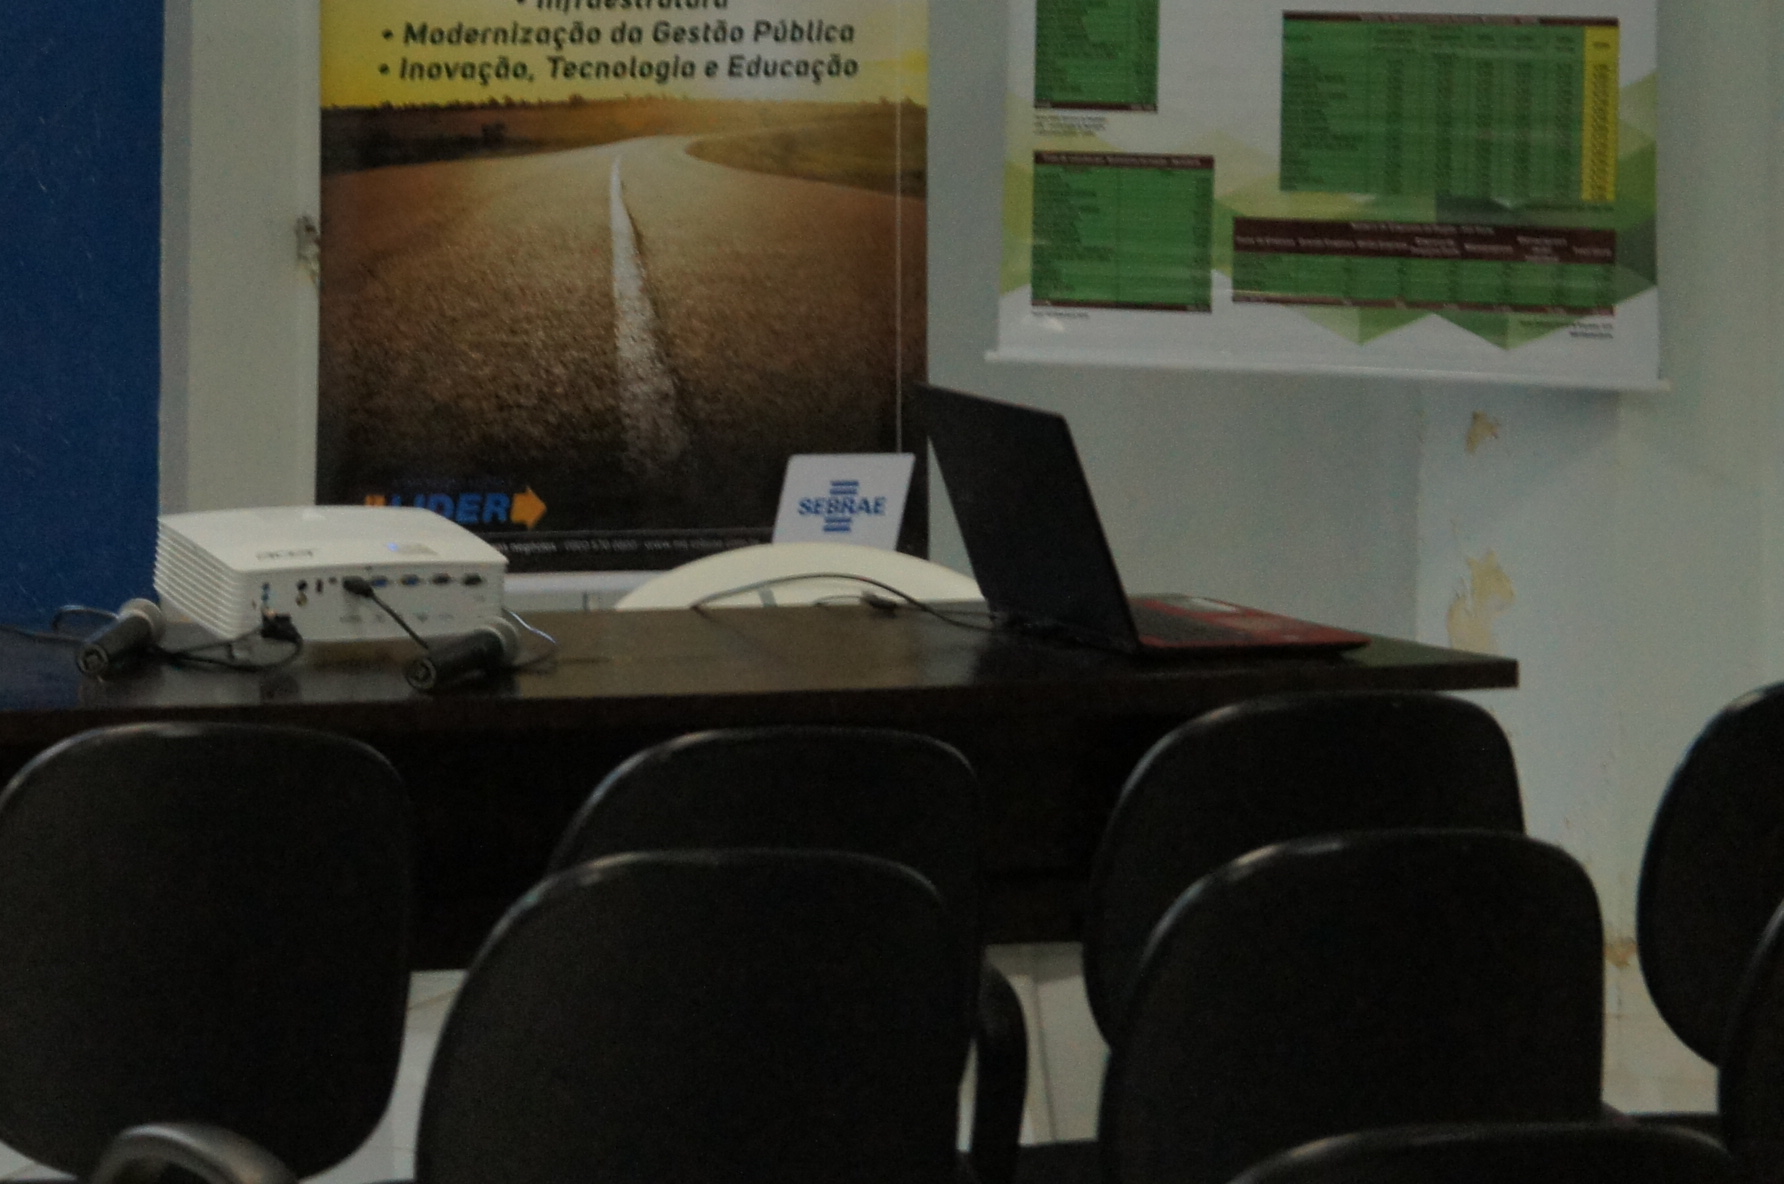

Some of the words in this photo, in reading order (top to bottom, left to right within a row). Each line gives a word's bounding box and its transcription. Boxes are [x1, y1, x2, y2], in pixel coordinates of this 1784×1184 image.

[403, 21, 603, 52] Modernização
[609, 21, 643, 46] da
[652, 21, 744, 46] Gestão
[752, 19, 855, 44] Pública
[399, 56, 535, 85] Inovação,
[548, 55, 697, 85] Tecnologia
[704, 61, 719, 80] e
[727, 53, 859, 85] Educação
[799, 496, 885, 516] SEBRAE
